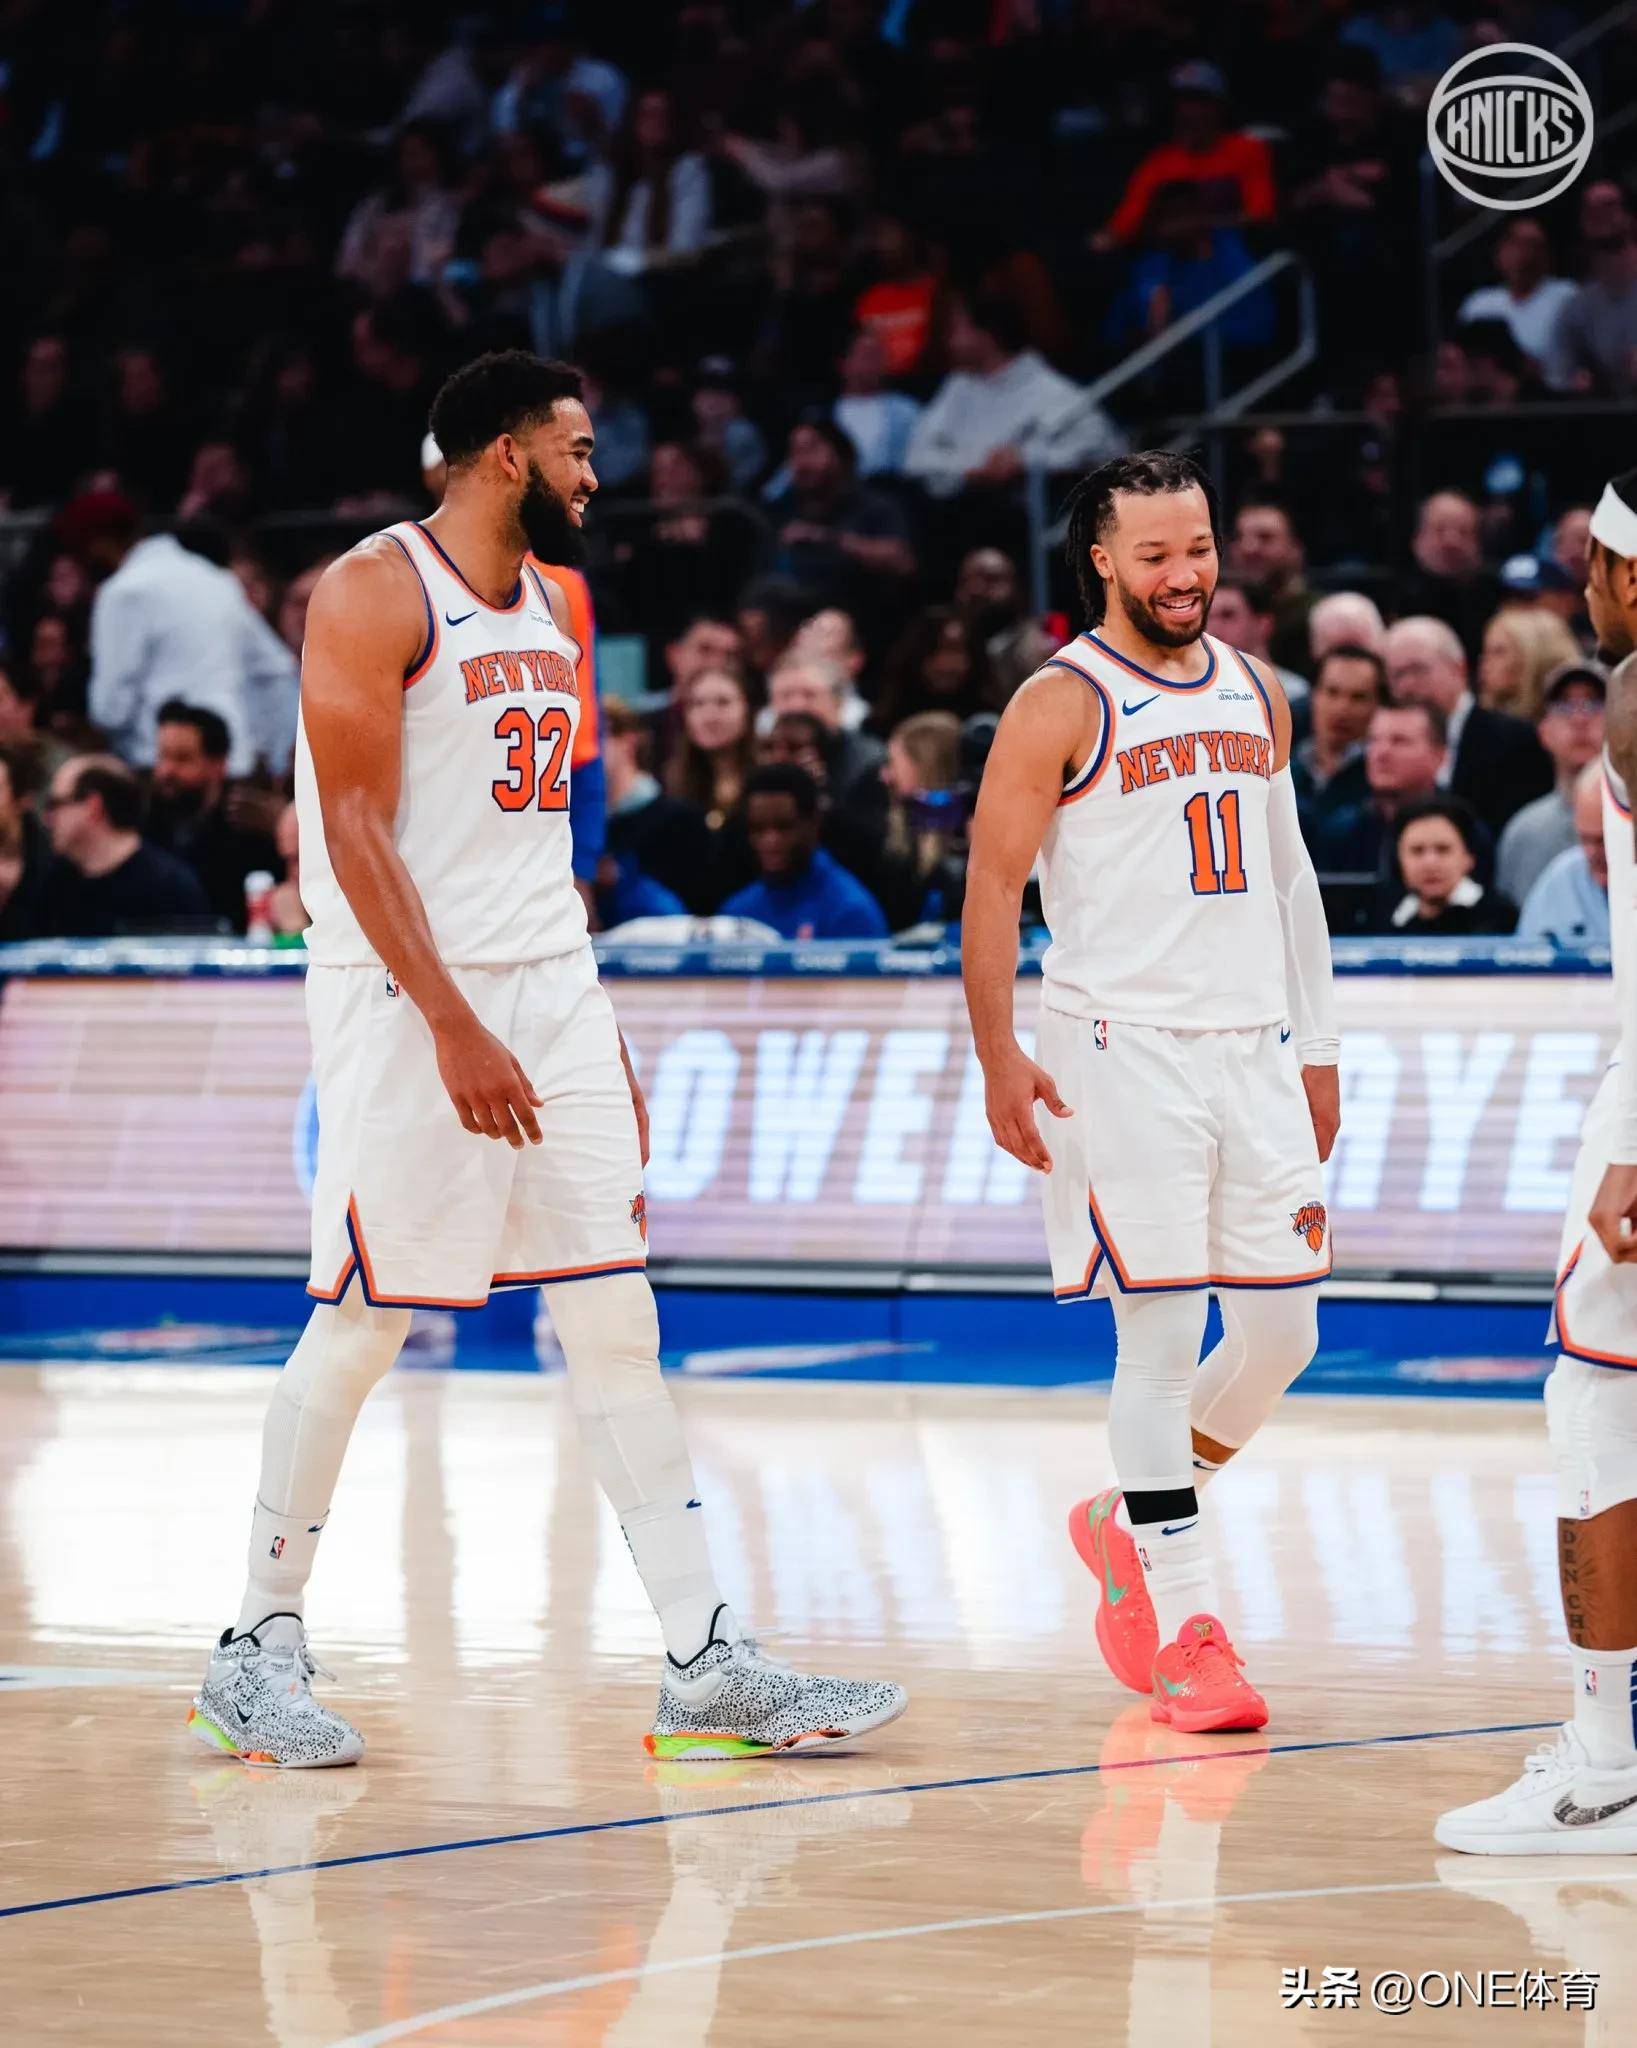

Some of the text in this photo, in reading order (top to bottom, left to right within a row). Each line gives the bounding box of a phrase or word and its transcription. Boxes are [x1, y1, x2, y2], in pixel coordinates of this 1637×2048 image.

[459, 651, 524, 704] NEW
[492, 707, 571, 812] 32
[1117, 730, 1271, 795] NEW YORK
[1184, 789, 1248, 895] 11
[620, 1030, 1040, 1205] OWE
[1562, 1519, 1579, 1584] DEN
